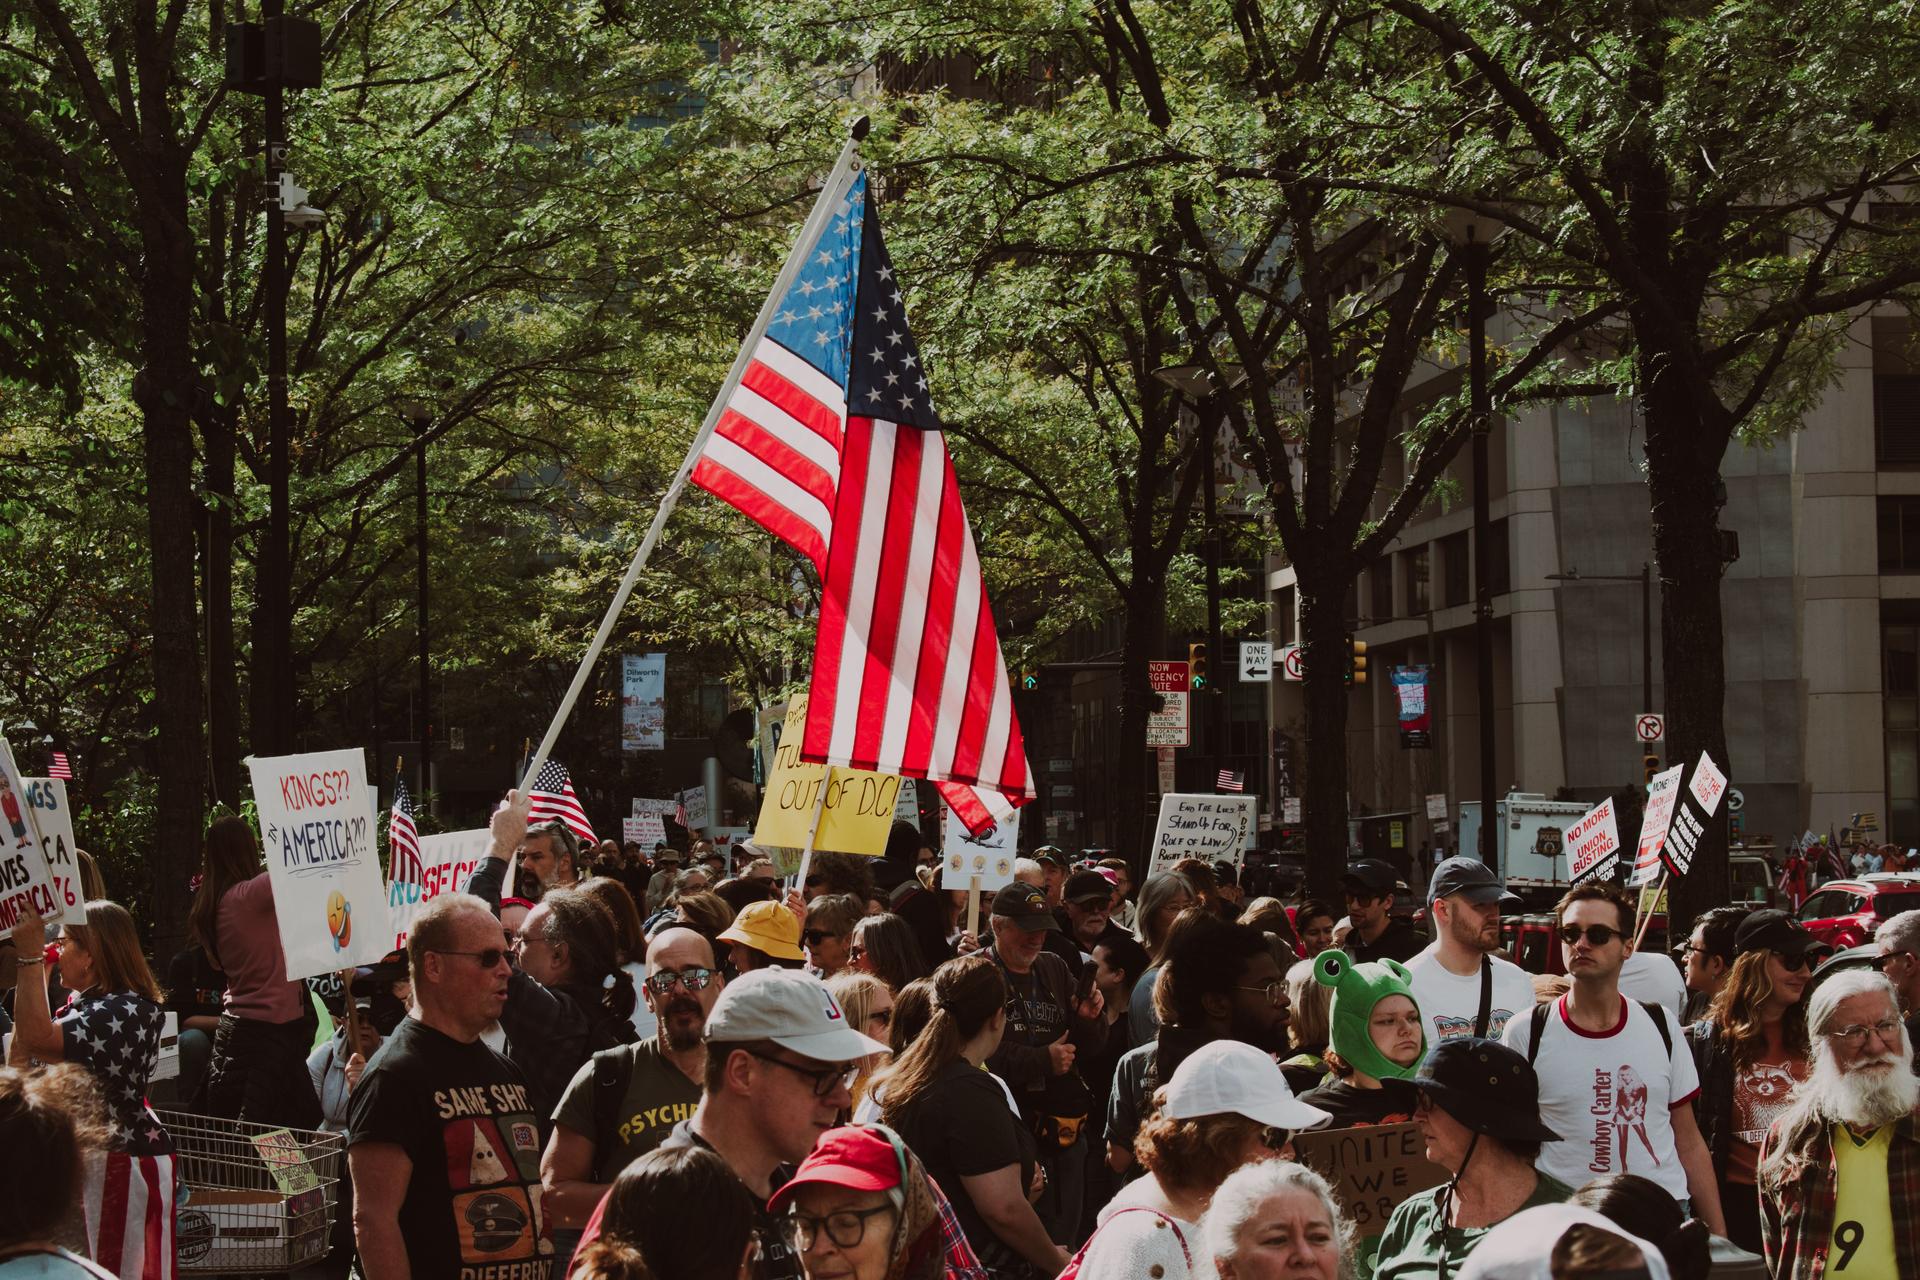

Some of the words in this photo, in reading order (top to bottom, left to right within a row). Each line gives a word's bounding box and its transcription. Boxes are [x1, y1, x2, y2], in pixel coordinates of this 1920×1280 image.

[1246, 656, 1267, 665] WAY
[1247, 646, 1267, 655] ONE
[626, 668, 660, 677] Dilworth
[1148, 673, 1185, 682] RGENCY
[1149, 663, 1170, 672] NOW
[1151, 682, 1172, 691] UTE
[280, 769, 351, 811] KINGS??
[780, 779, 823, 810] OUT
[826, 777, 854, 810] OF
[1539, 832, 1561, 842] POLICE
[1567, 826, 1582, 845] NO
[1583, 804, 1610, 833] MORE
[283, 815, 367, 867] AMERICA?!?
[1201, 836, 1223, 848] LAW
[1577, 830, 1606, 859] UNION
[1573, 837, 1614, 875] BUSTING
[1595, 853, 1620, 879] UNION
[434, 1086, 493, 1120] SAME
[1591, 1068, 1612, 1116] Carter
[618, 1103, 700, 1145] PSYCH
[1589, 1119, 1616, 1173] Cowboy
[1350, 1166, 1409, 1193] WE
[1834, 1220, 1865, 1271] 9
